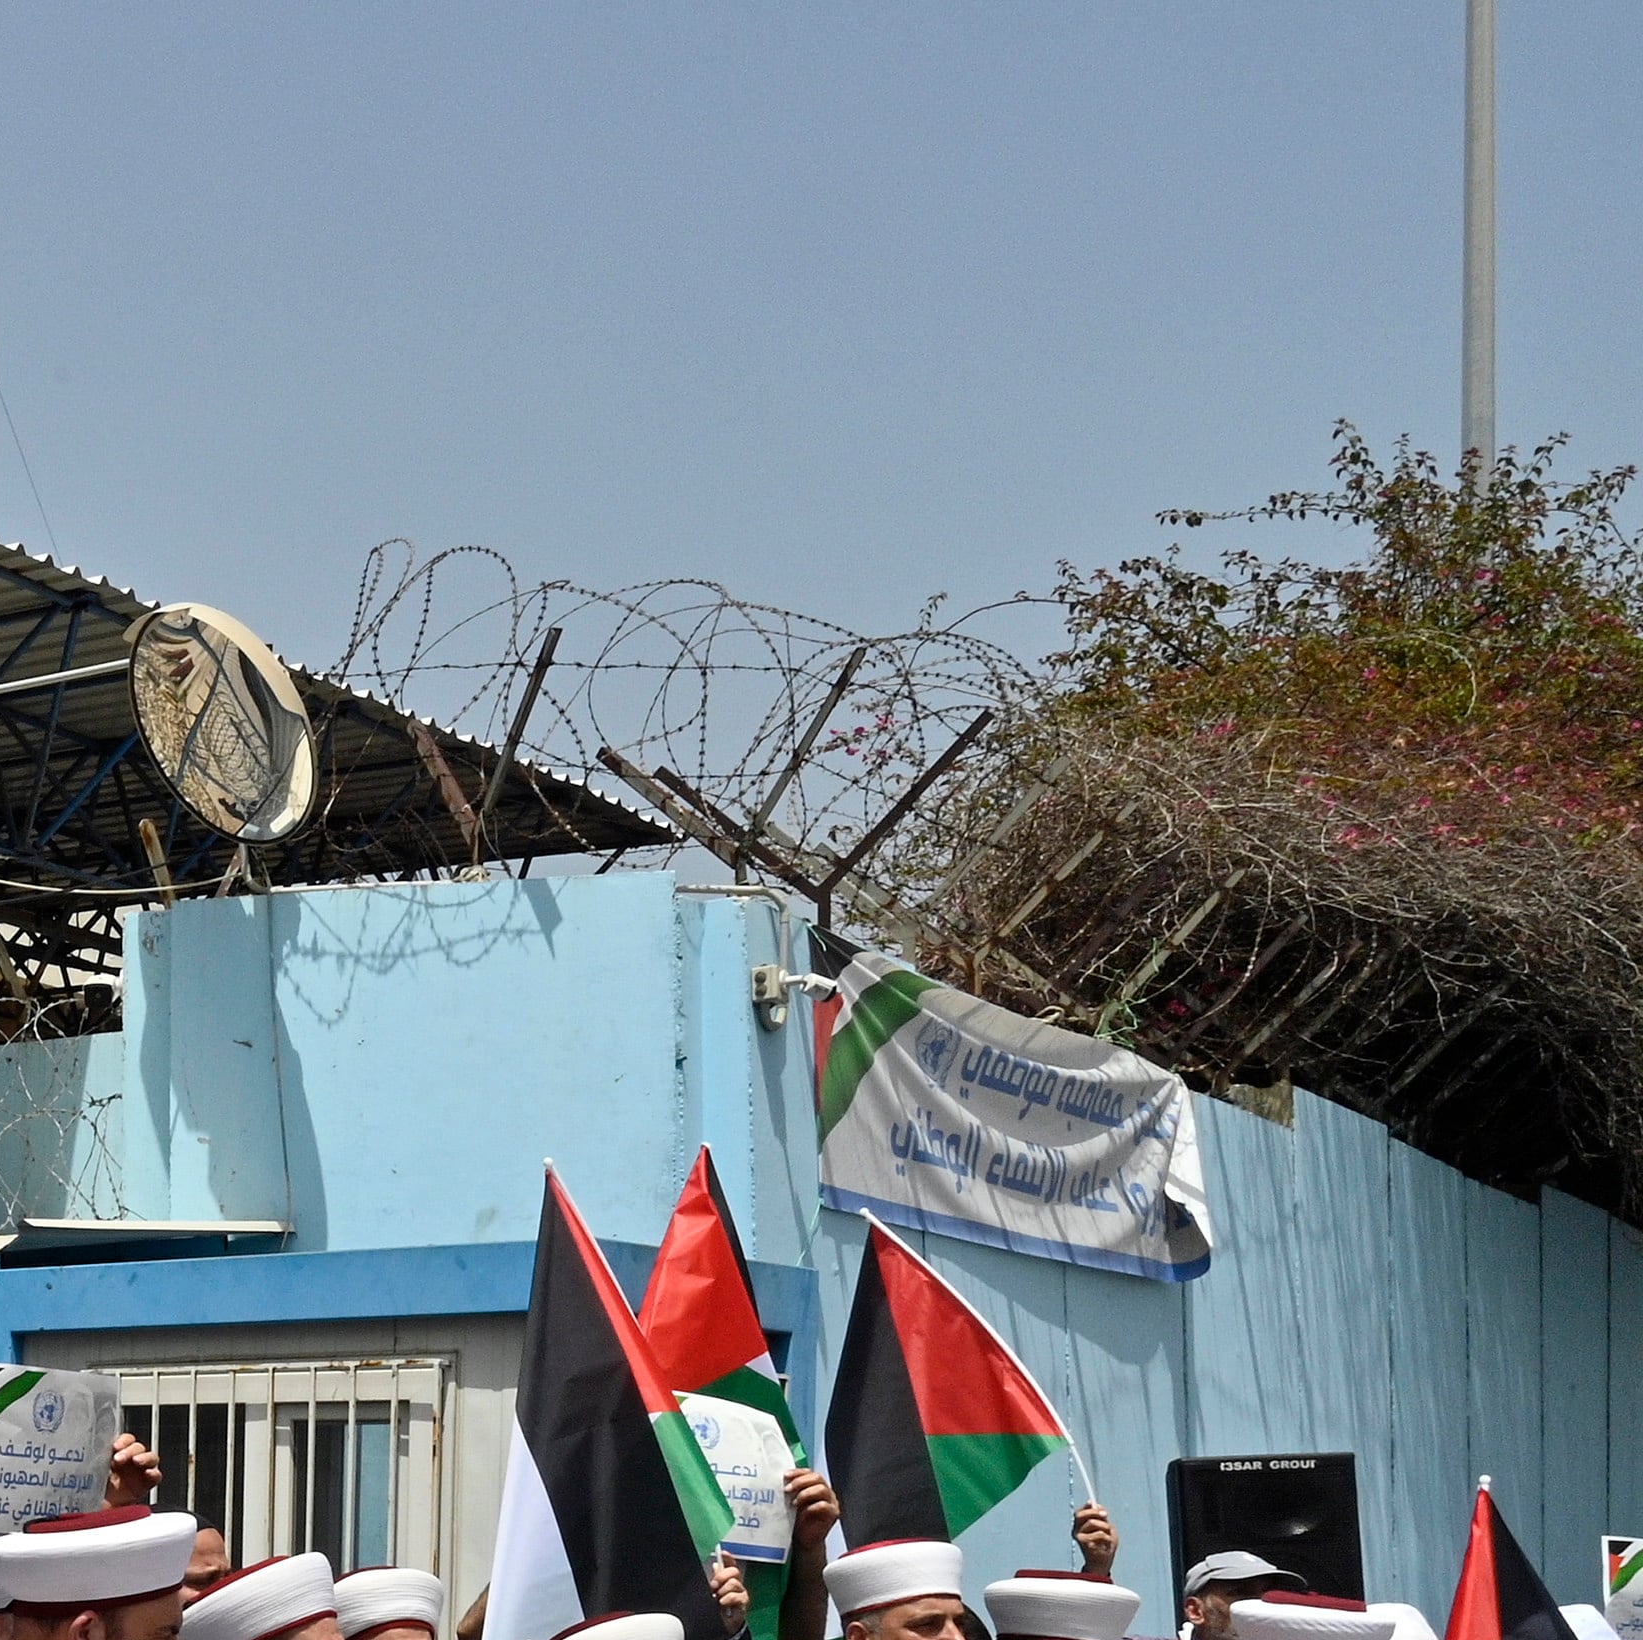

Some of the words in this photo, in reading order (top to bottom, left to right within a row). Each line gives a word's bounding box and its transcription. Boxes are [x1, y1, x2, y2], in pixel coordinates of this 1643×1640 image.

[48, 1446, 86, 1465] ندعو
[12, 1498, 32, 1526] في
[737, 1512, 761, 1529] ضد
